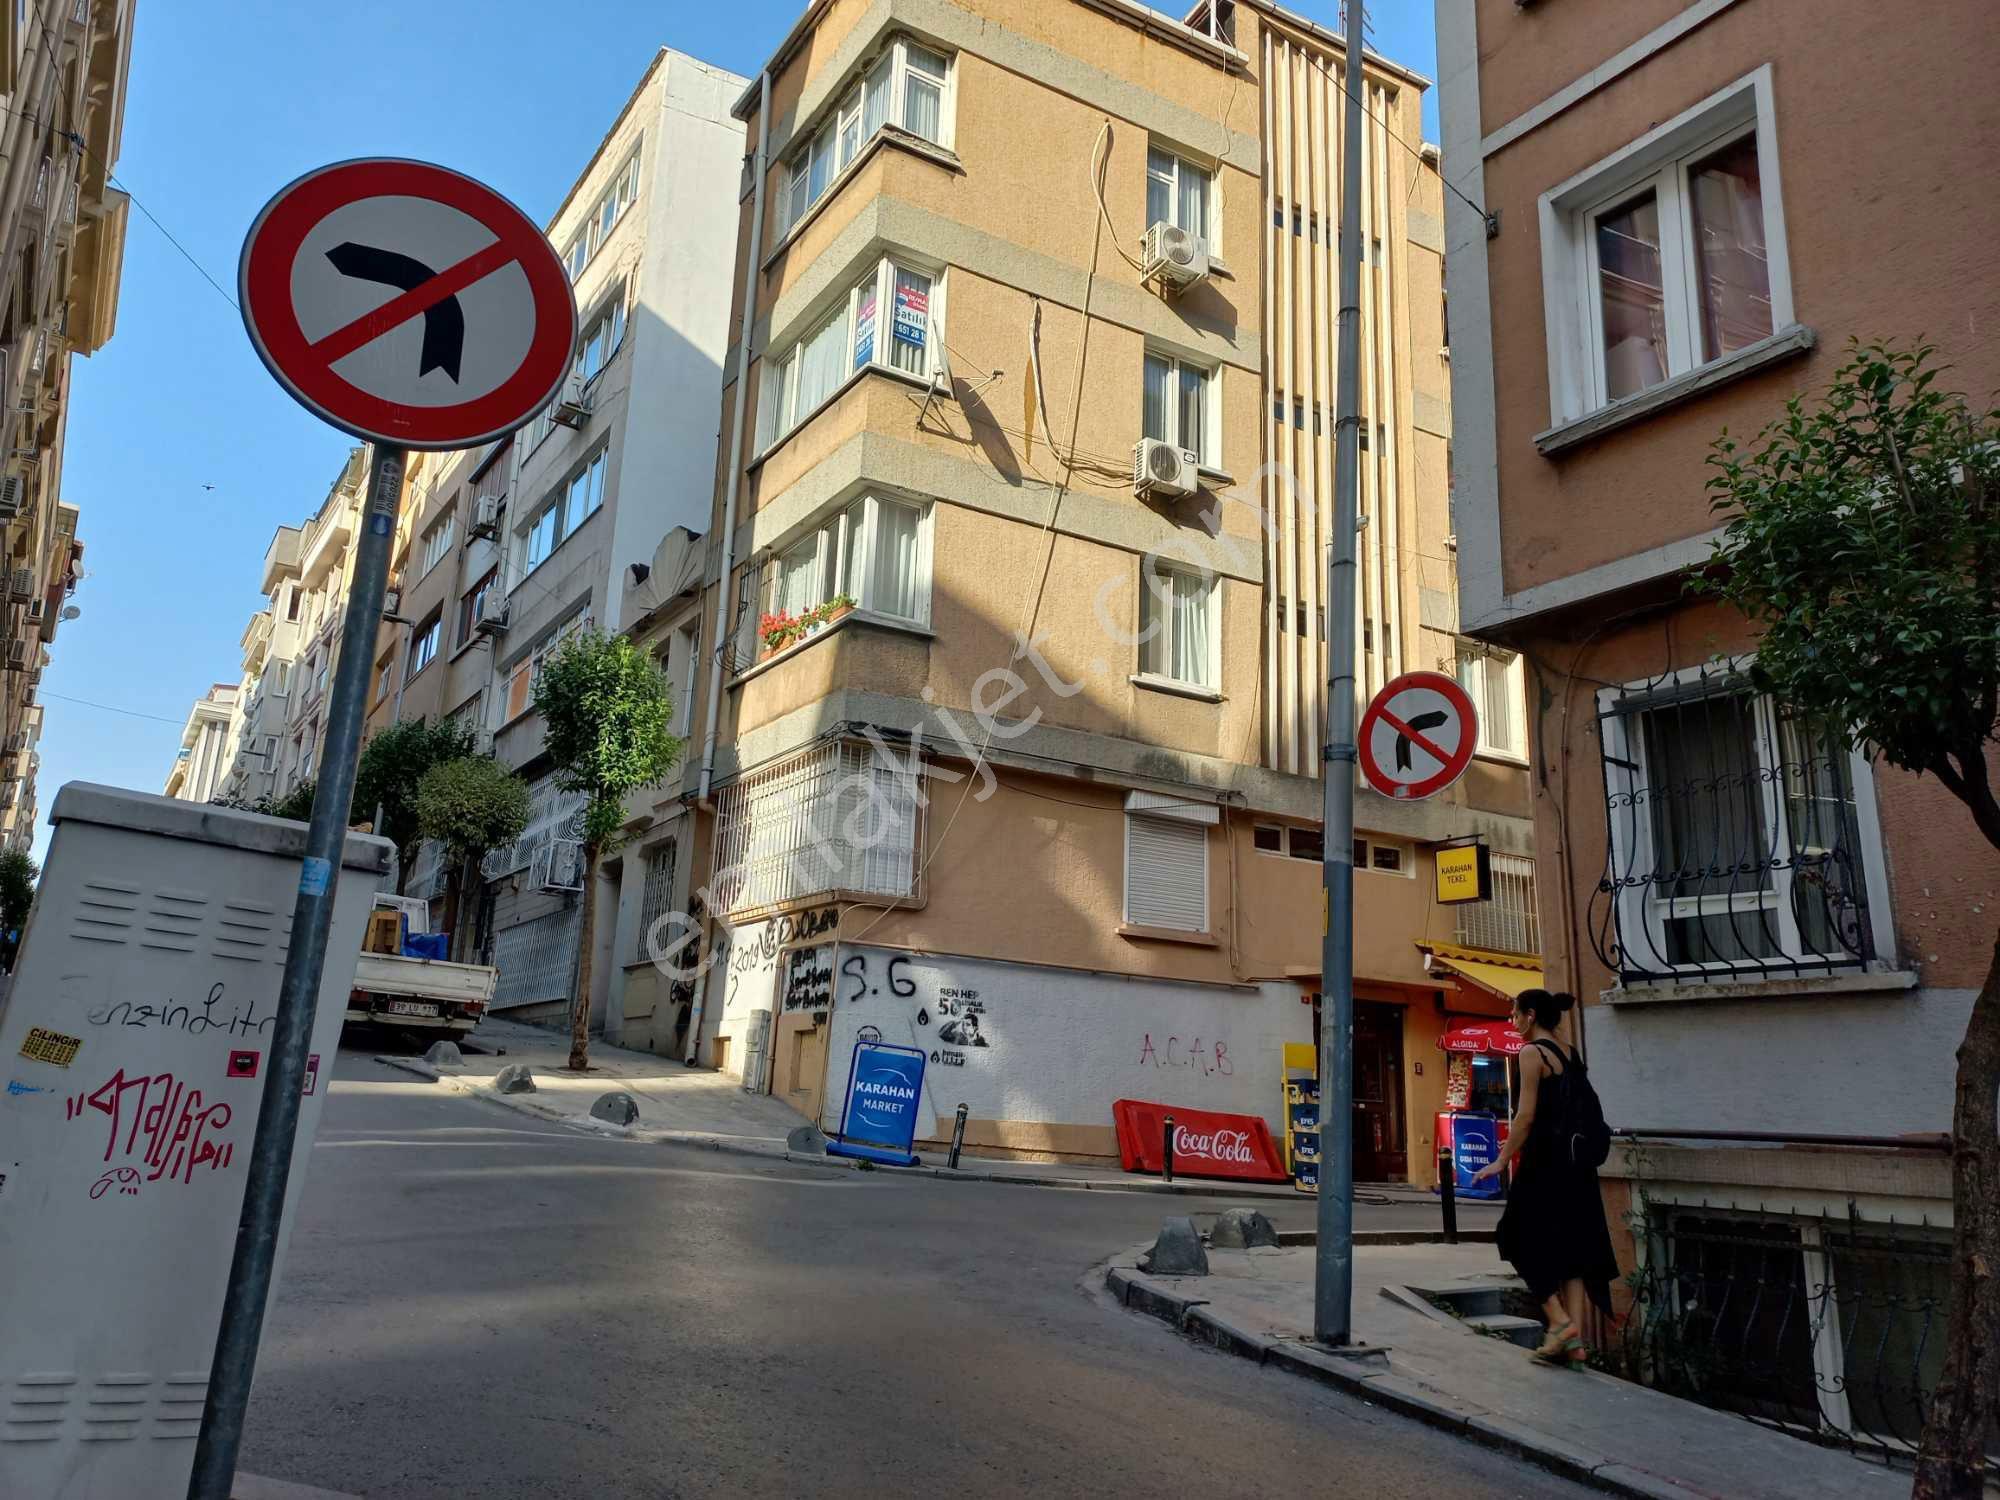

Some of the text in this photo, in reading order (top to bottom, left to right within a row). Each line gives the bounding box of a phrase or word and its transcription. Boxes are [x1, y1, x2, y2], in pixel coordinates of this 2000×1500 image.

[1441, 863, 1473, 874] KARAHAN
[1447, 875, 1467, 885] TEKEL
[1451, 1041, 1478, 1049] ALGIDA
[856, 1081, 915, 1100] KARAHAN
[863, 1098, 905, 1114] MARKET
[1300, 1117, 1314, 1126] EFES
[1173, 1124, 1255, 1163] Coca-Cola
[1460, 1143, 1487, 1151] KARAHAN
[1301, 1146, 1314, 1155] EFES
[1473, 1156, 1489, 1165] TEKEL
[1302, 1175, 1316, 1184] EFES
